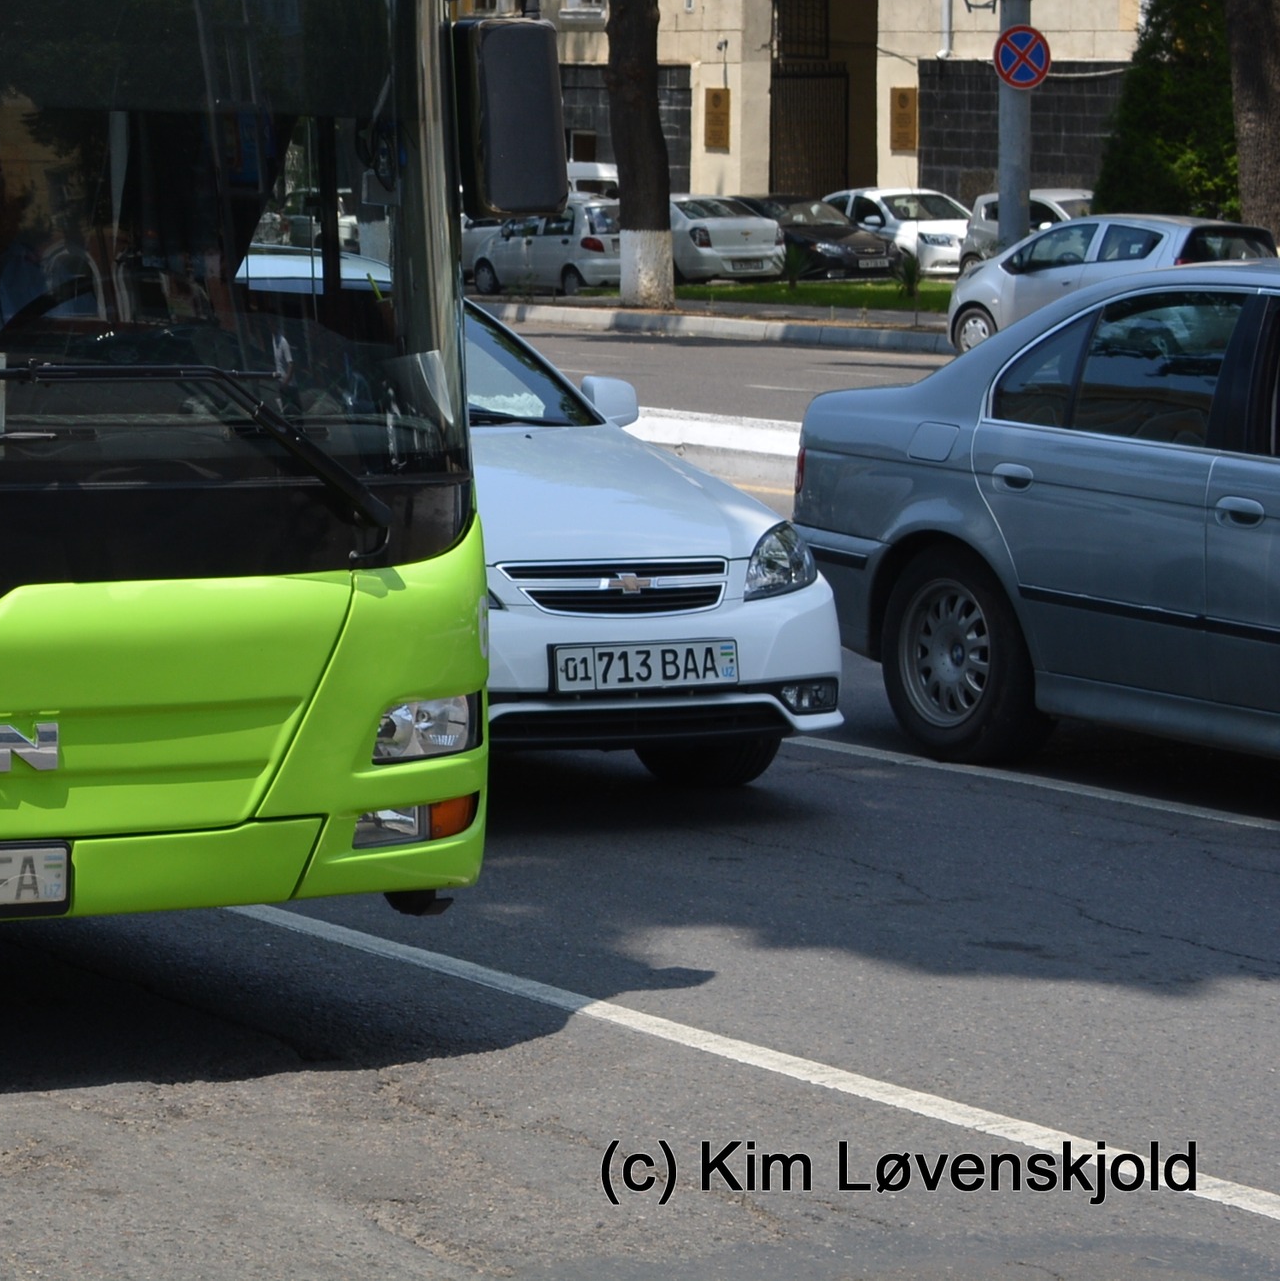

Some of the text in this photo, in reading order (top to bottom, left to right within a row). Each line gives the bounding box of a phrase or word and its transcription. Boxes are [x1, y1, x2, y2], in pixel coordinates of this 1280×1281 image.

[564, 657, 592, 682] 01
[597, 650, 652, 684] 713
[661, 647, 719, 680] BAA
